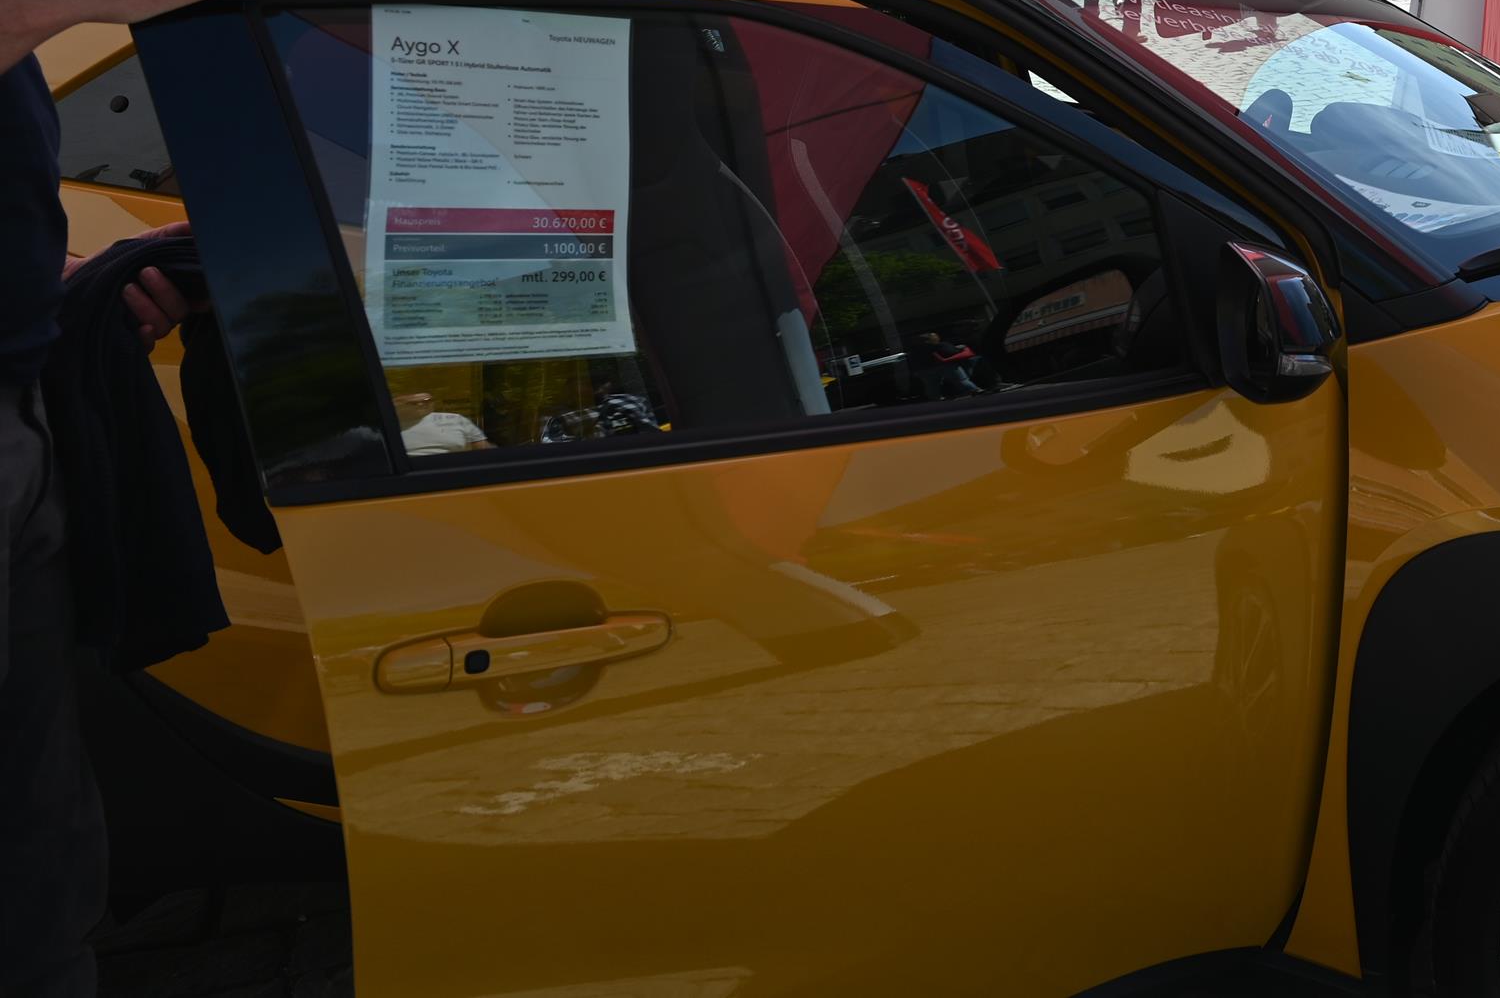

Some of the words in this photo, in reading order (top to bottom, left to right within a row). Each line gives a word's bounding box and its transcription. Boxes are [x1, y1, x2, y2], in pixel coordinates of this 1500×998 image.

[391, 35, 441, 57] Aygo
[447, 39, 460, 56] X
[549, 34, 572, 44] Toyota
[573, 36, 616, 46] NEUWAGEN
[532, 217, 596, 230] 30.670,00
[599, 217, 607, 229] €
[543, 242, 595, 256] 1.100,00
[598, 242, 607, 254] €
[422, 268, 453, 278] Toyota
[521, 271, 548, 283] mtl.
[551, 270, 595, 284] 299,00
[598, 270, 607, 282] €
